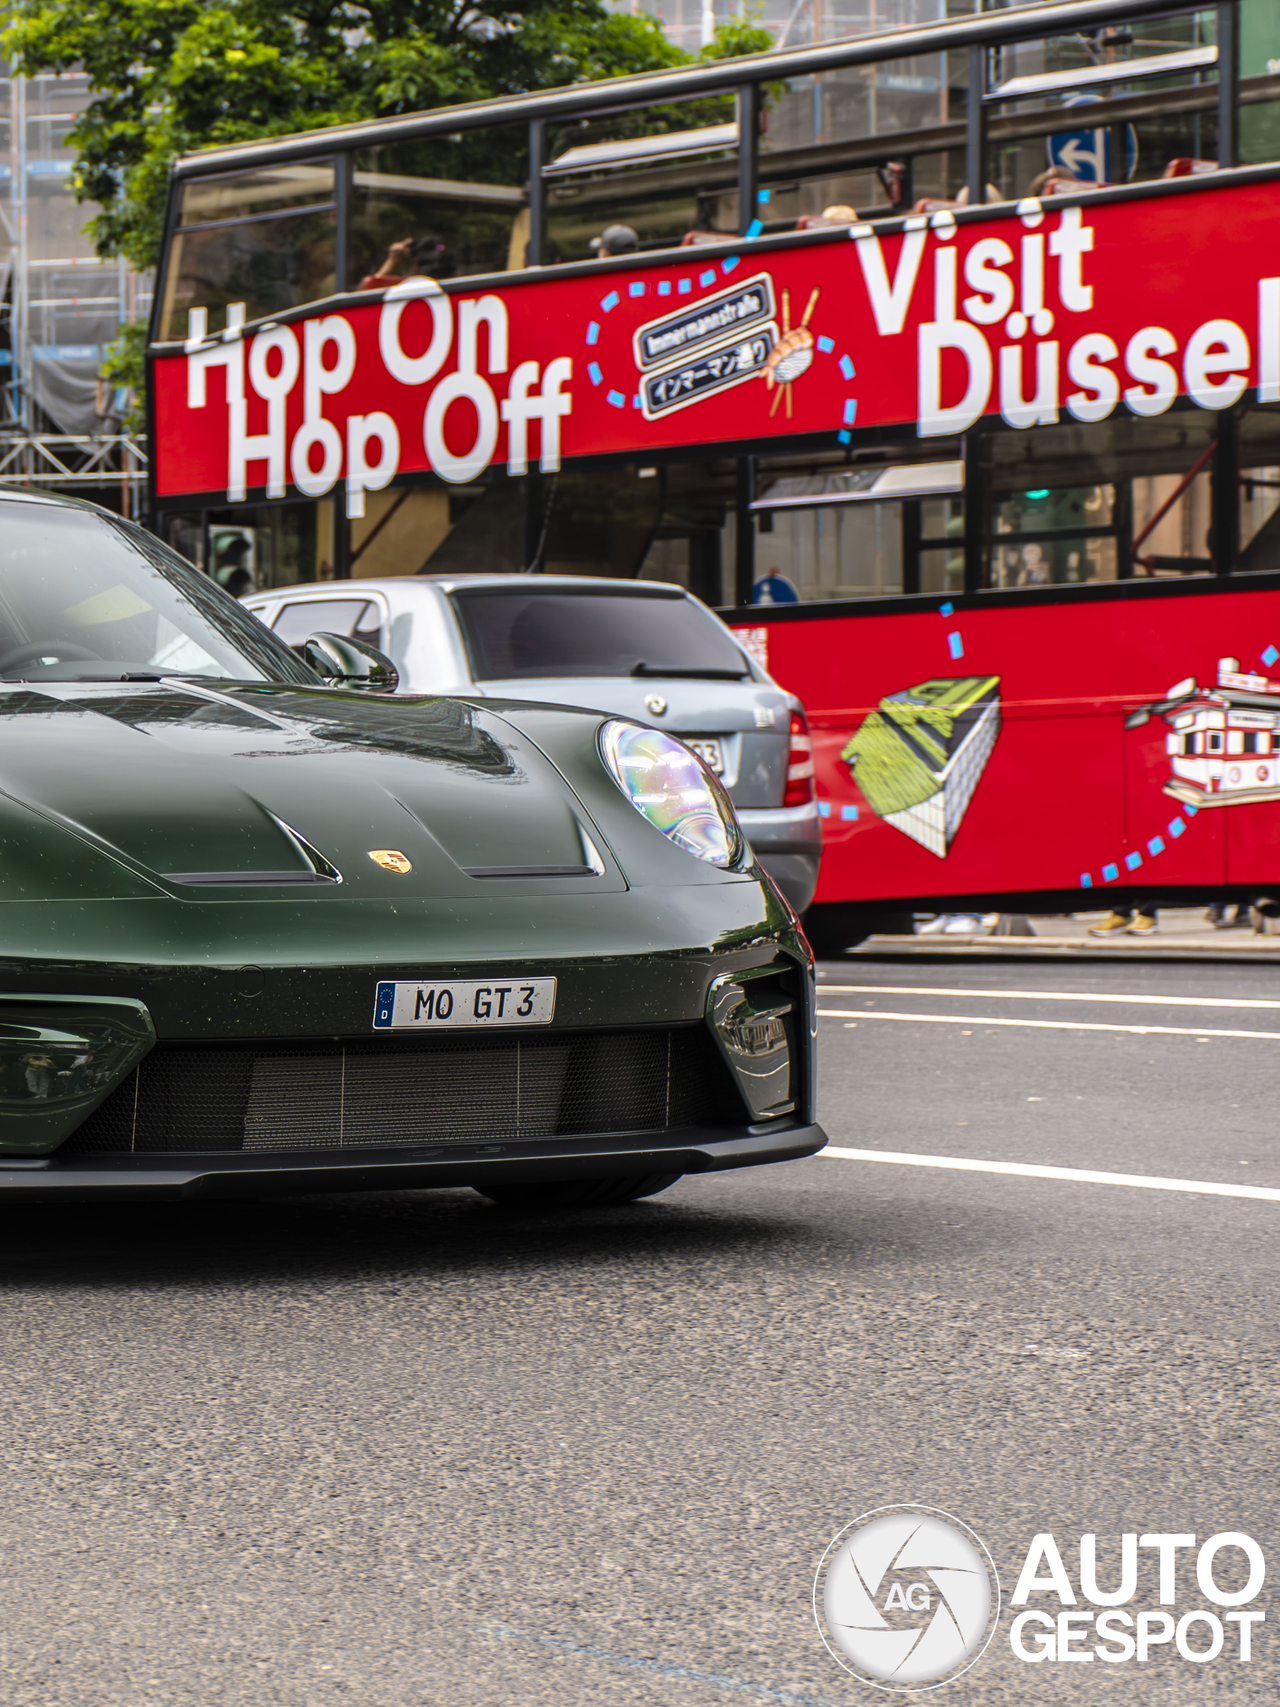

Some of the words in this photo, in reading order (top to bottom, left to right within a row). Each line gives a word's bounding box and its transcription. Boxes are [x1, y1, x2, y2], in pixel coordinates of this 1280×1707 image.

[849, 197, 1094, 336] Visit
[187, 302, 356, 421] Hop
[379, 276, 508, 384] On
[228, 398, 400, 518] Hop
[424, 357, 572, 483] Off
[381, 1010, 388, 1019] D
